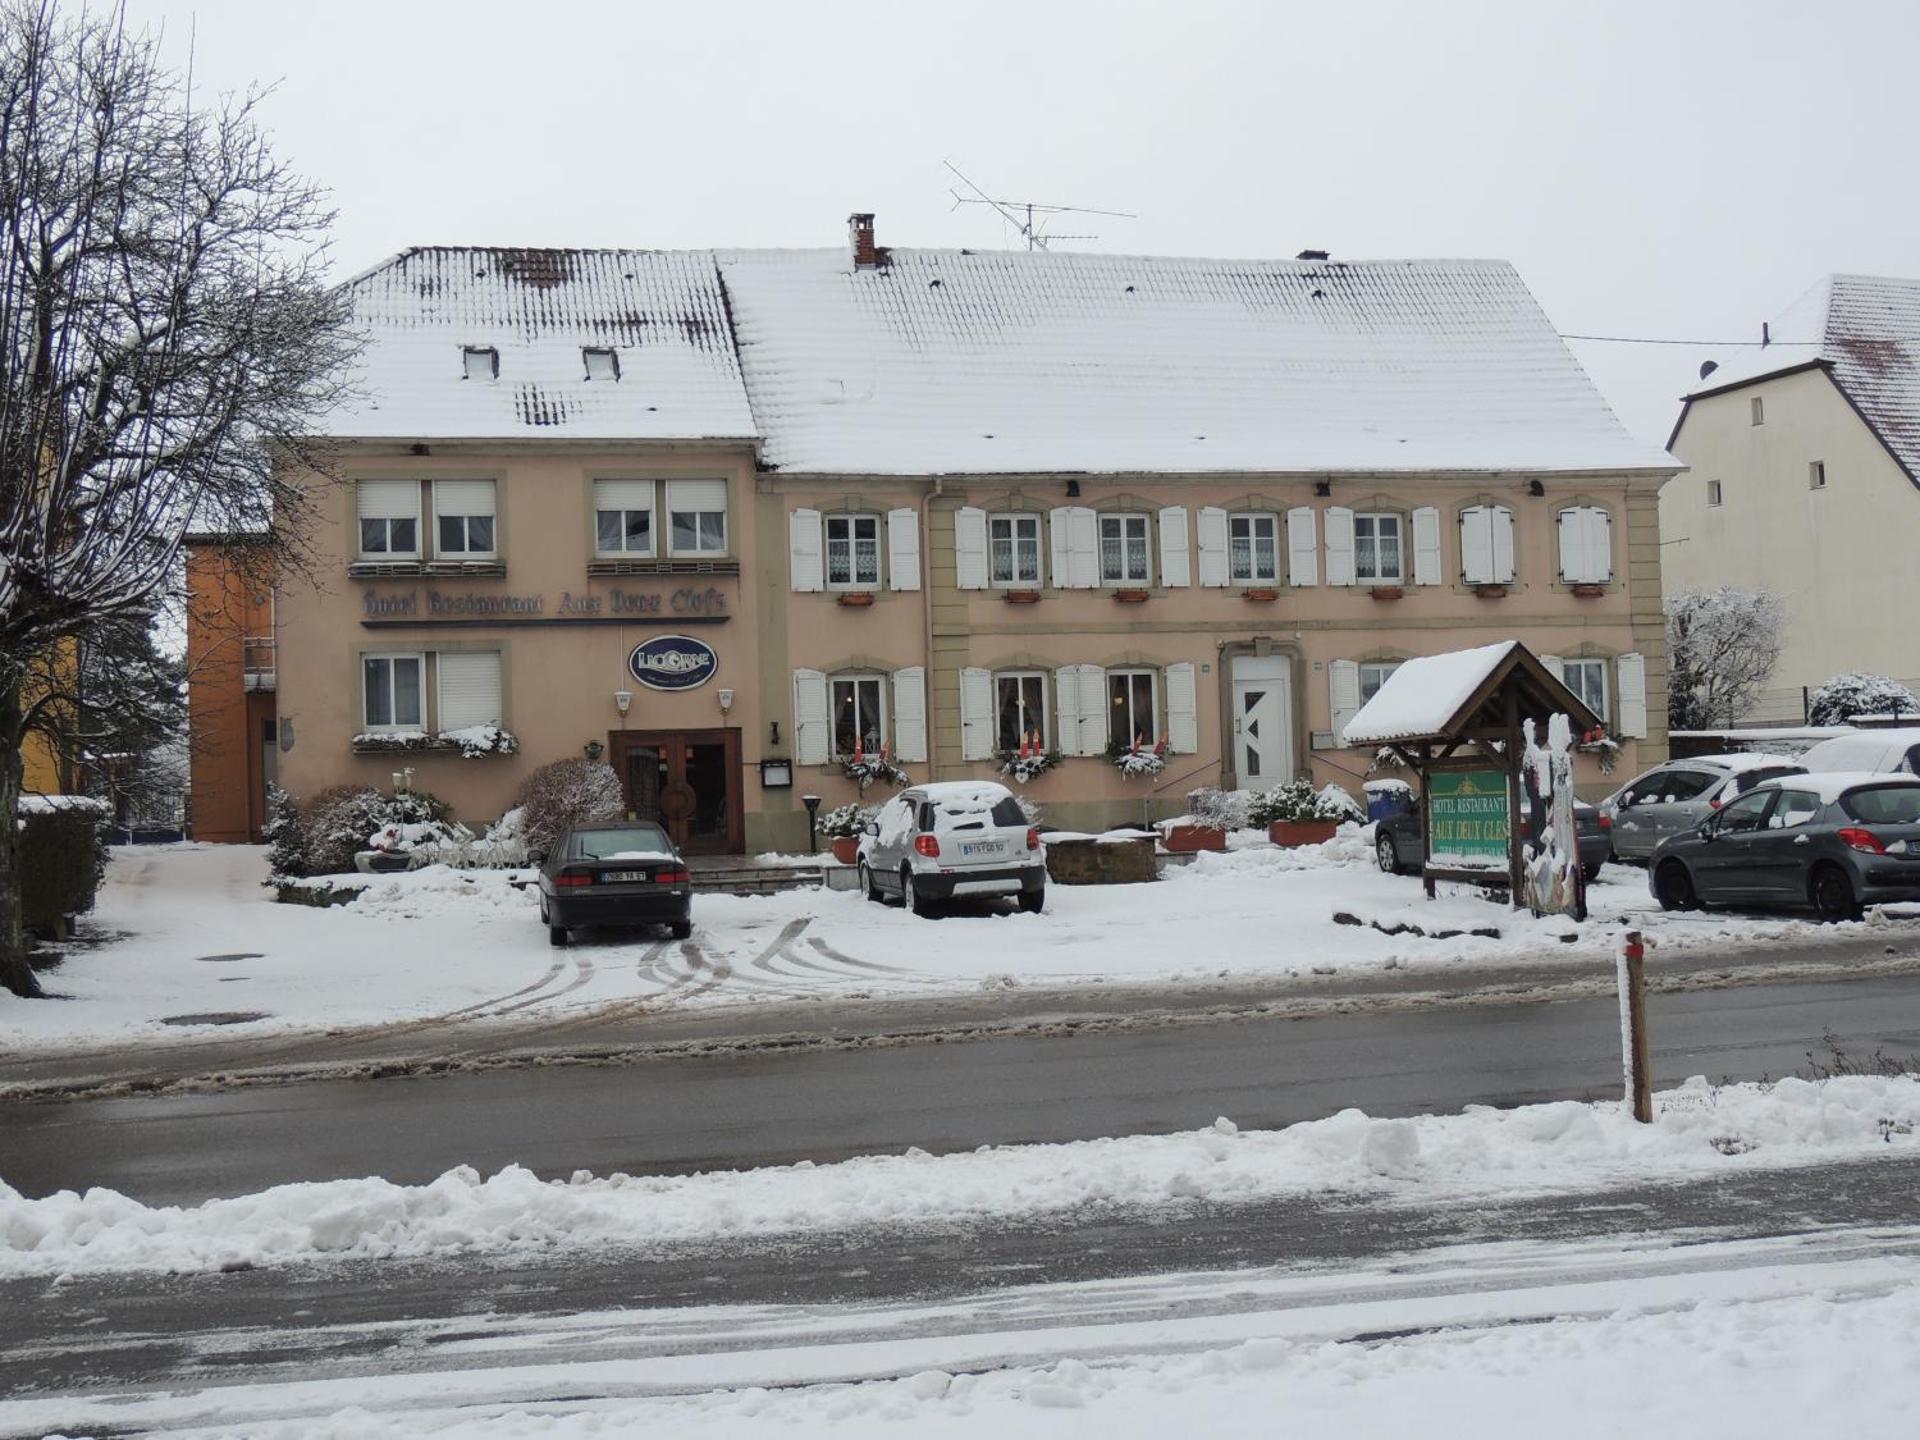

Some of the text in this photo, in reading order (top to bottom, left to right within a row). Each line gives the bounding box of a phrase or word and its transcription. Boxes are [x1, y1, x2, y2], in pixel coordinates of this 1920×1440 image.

[427, 588, 544, 615] Restaurant
[558, 591, 601, 614] Aux
[611, 588, 661, 613] Deux
[671, 586, 727, 613] Clefs
[638, 650, 710, 673] LICORNE
[1433, 797, 1505, 813] HOTEL RESTAURANT
[1435, 820, 1454, 840] AUX
[1456, 820, 1480, 840] DEUX
